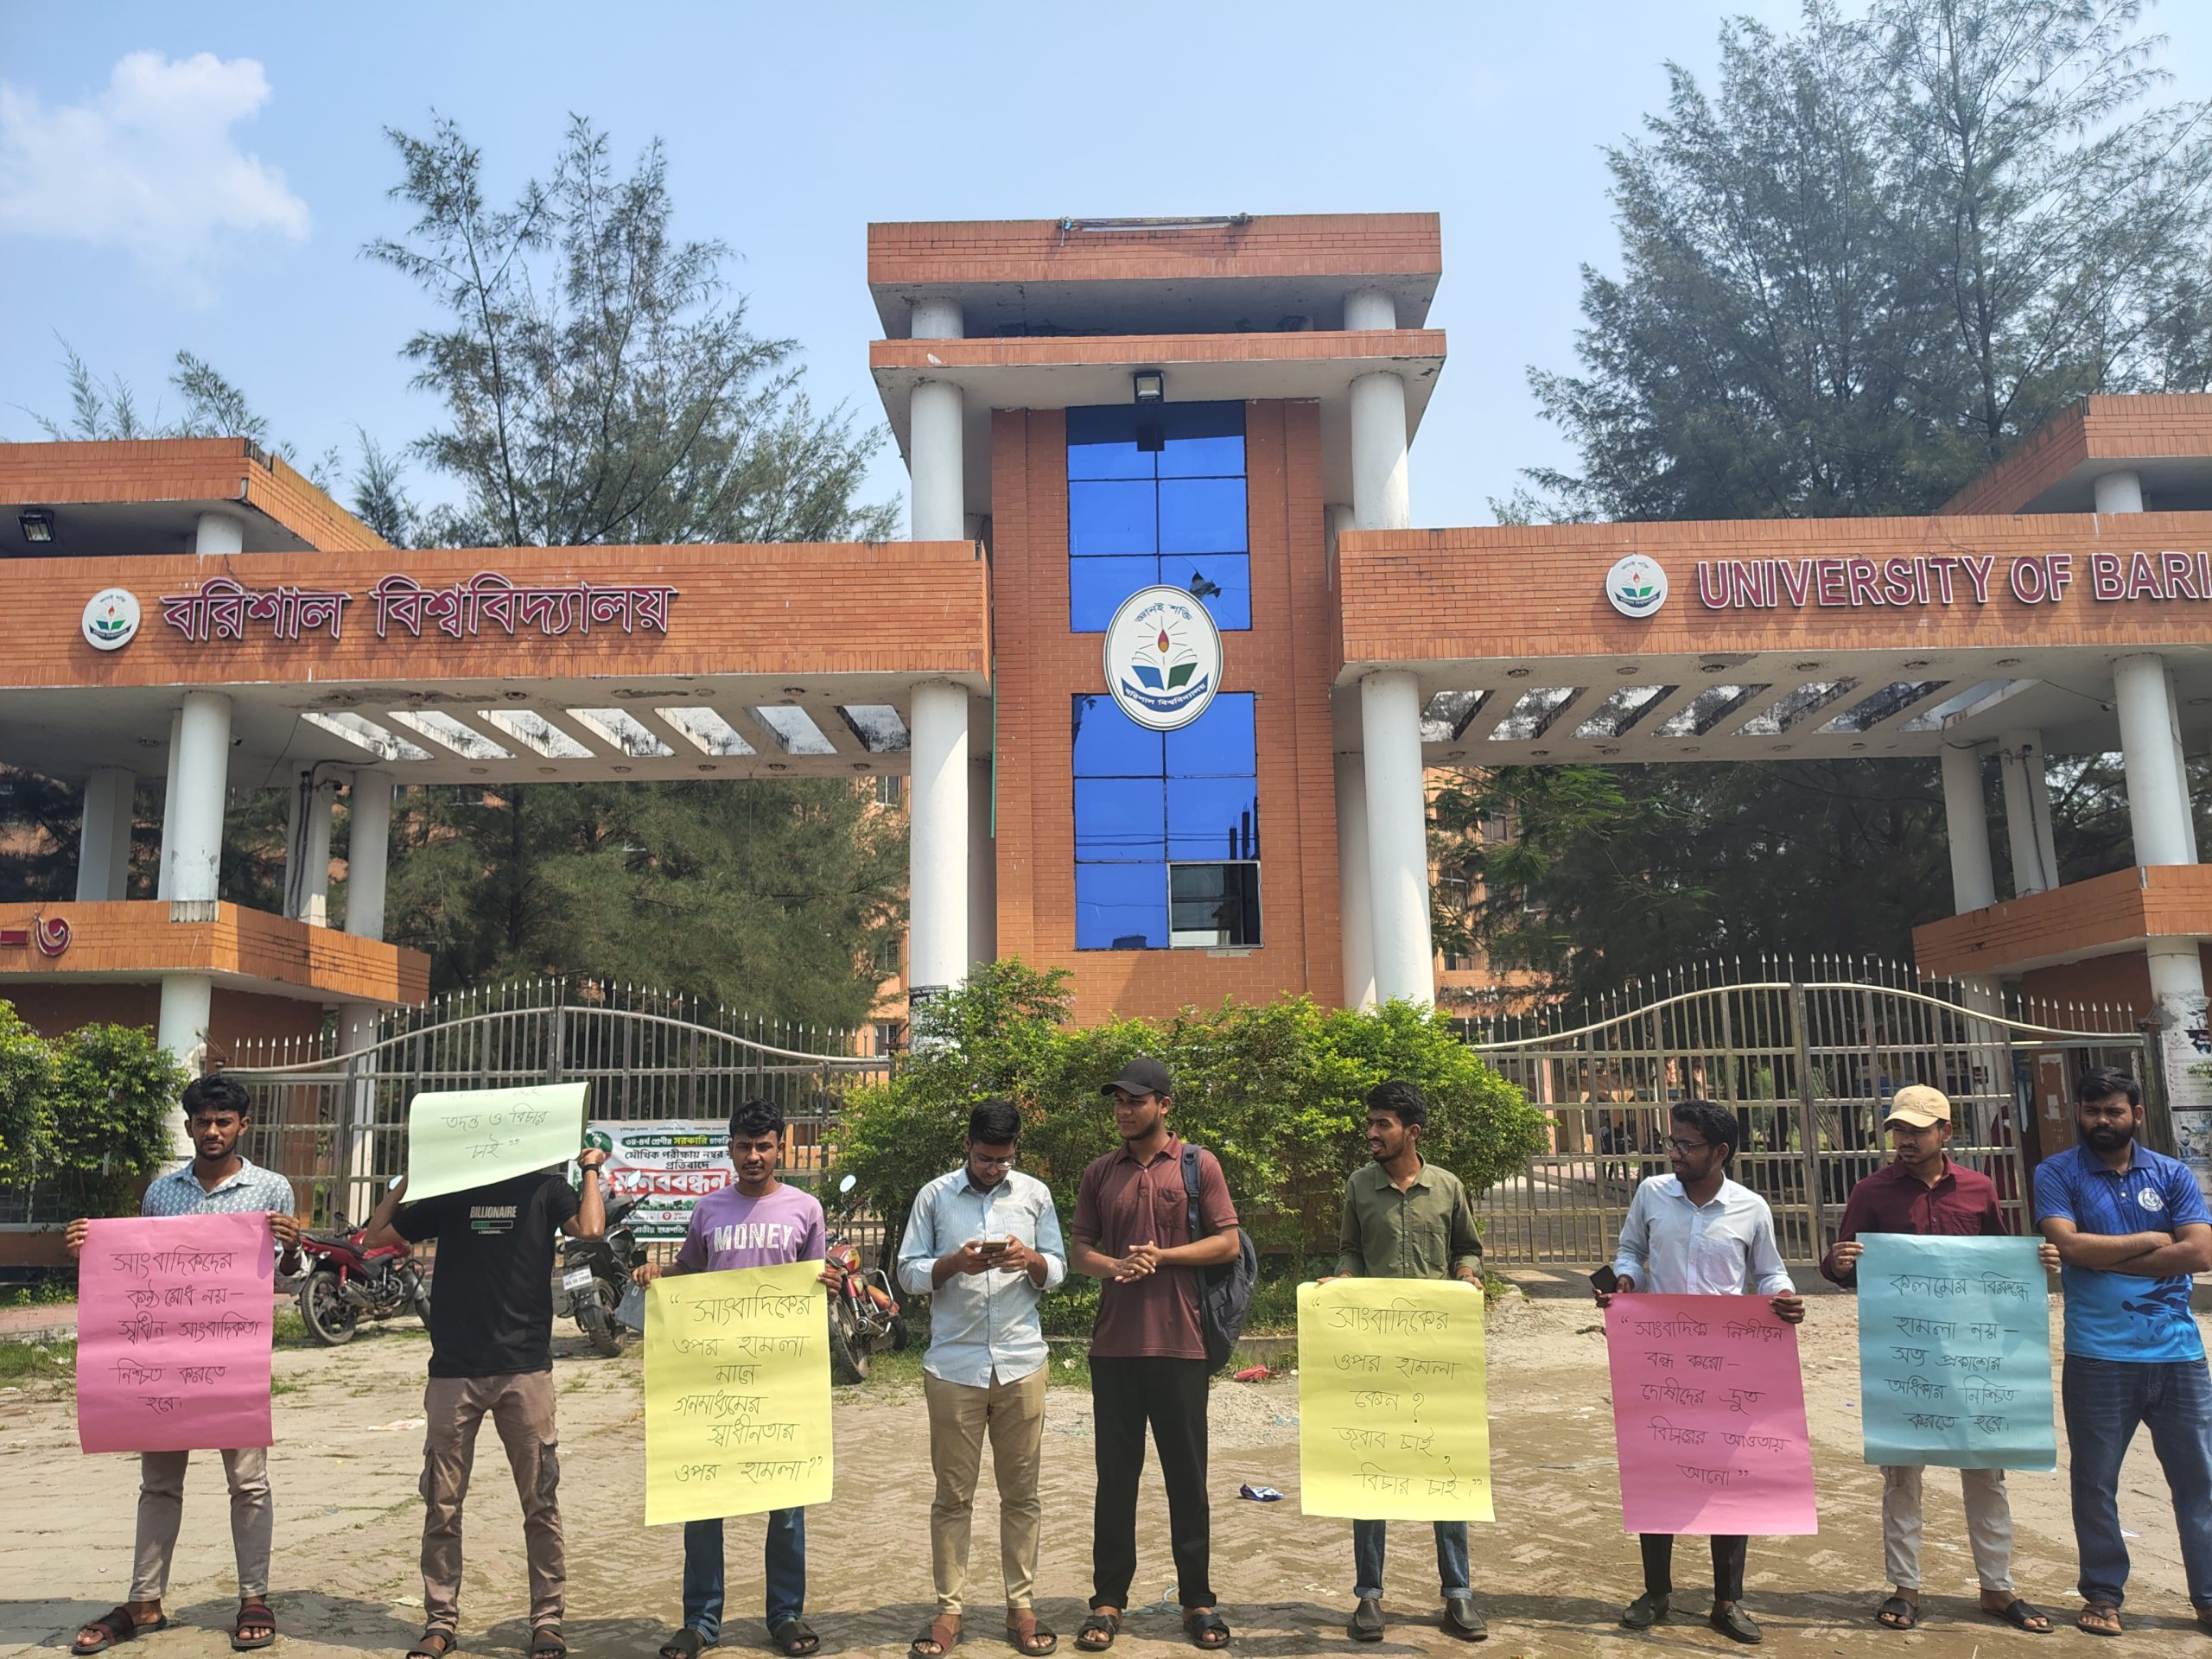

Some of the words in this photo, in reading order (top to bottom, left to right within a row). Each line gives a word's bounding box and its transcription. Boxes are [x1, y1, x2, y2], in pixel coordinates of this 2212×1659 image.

[1698, 556, 1995, 608] UNIVERSITY
[2011, 553, 2073, 604] OF
[2091, 551, 2212, 601] BARI
[159, 576, 352, 641] বরিশাল
[368, 571, 679, 639] বিশ্ববিদ্যালয়
[489, 1113, 502, 1126] ও
[508, 1103, 551, 1126] বিচার
[674, 1135, 708, 1146] সরকারি
[625, 1148, 659, 1160] মৌখিক
[662, 1148, 701, 1160] পরীক্ষায়
[665, 1159, 710, 1170] প্রতিবাদে
[470, 1205, 518, 1218] BILLIONAIRE
[714, 1223, 793, 1253] MONEY
[110, 1244, 238, 1279] সাংবাদিকদের
[1889, 1274, 1969, 1298] কলমের
[1979, 1271, 2031, 1302] বিরুদ্ধে
[118, 1311, 168, 1345] স্বাধীন
[178, 1311, 262, 1343] সাংবাদিকতা
[1892, 1316, 1957, 1339] হামলা
[673, 1338, 725, 1357] ওপর
[736, 1336, 810, 1358] হামলা
[1334, 1354, 1382, 1374] ওপর
[1395, 1356, 1463, 1380] হামলা
[1643, 1351, 1674, 1370] বন্ধ
[1890, 1346, 1930, 1367] সত্য
[1936, 1355, 2004, 1372] প্রকাশের
[176, 1366, 227, 1385] করতে
[714, 1364, 762, 1385] মানে
[1883, 1375, 1949, 1400] অধিকার
[706, 1414, 800, 1447] স্বাধীনতার
[1902, 1412, 1960, 1432] করতে
[1332, 1427, 1389, 1451] জবাব
[675, 1464, 721, 1482] ওপর
[1352, 1461, 1415, 1496] বিচার
